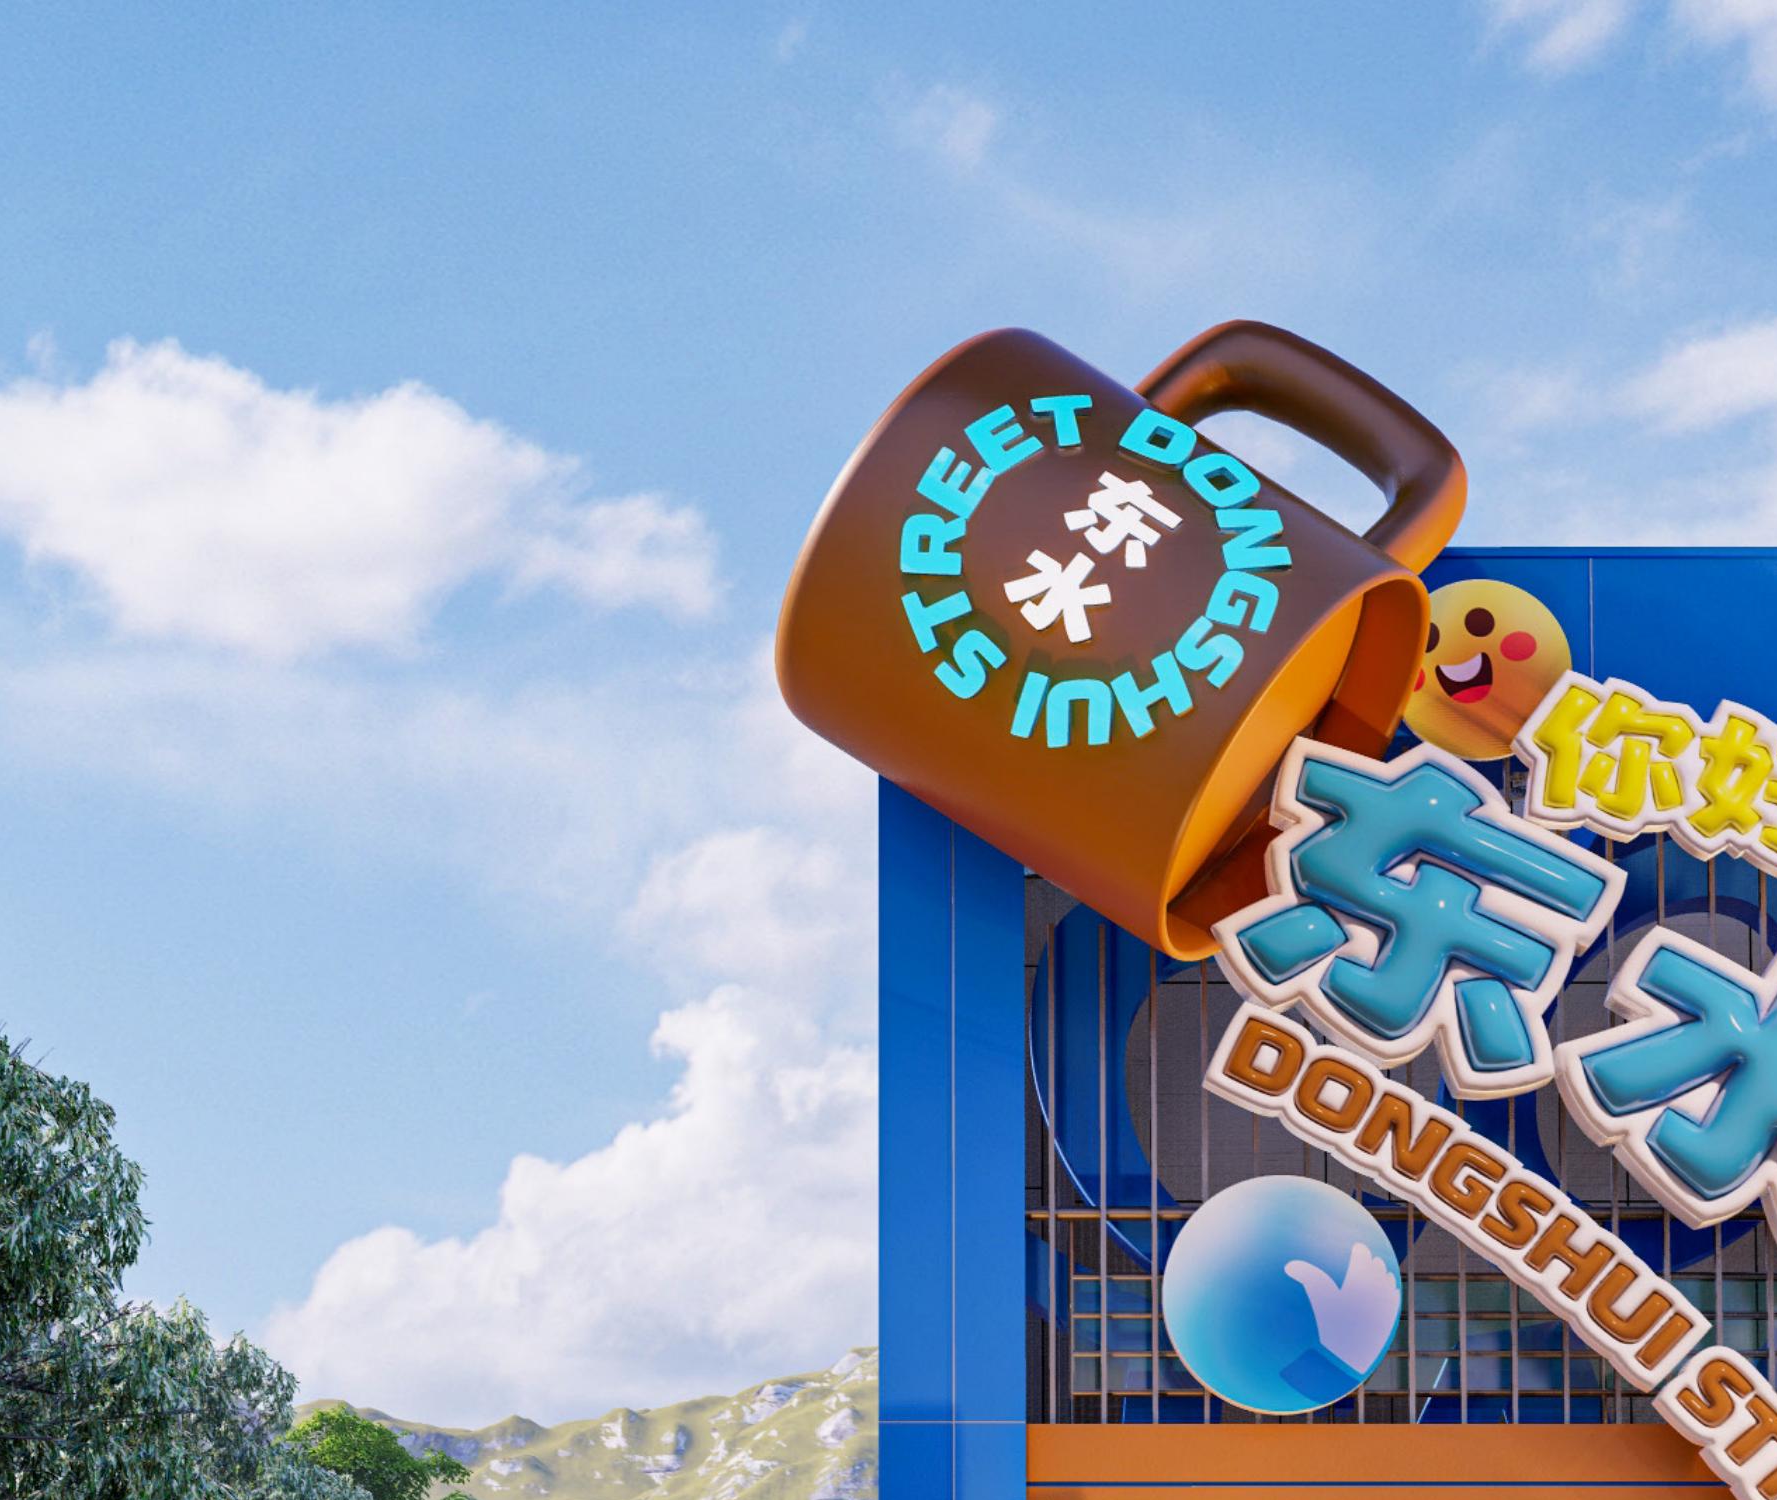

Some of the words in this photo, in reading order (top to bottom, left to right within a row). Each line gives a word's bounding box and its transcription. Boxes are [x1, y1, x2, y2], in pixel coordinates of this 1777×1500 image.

[899, 395, 1093, 698] STREET
[1010, 408, 1292, 748] DONGSHUI
[1003, 471, 1183, 642] 东水
[1223, 1016, 1694, 1370] DONGSHUI
